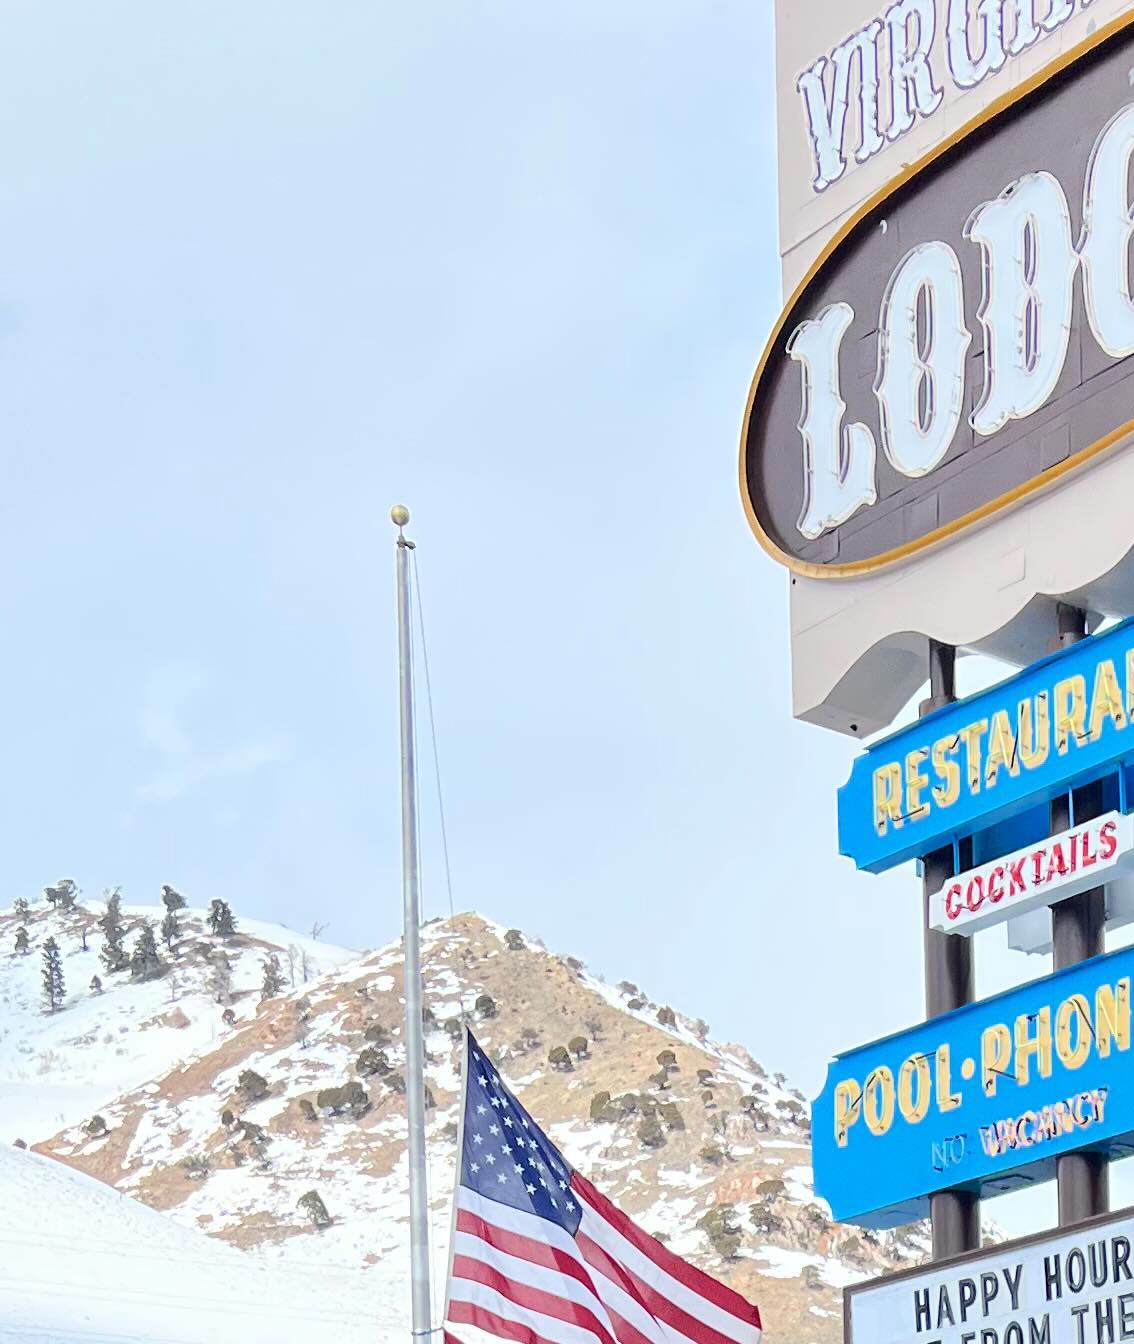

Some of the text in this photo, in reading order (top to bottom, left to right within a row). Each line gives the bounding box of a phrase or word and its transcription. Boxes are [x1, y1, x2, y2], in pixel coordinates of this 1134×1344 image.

[797, 0, 1092, 192] VIRG
[945, 821, 1118, 920] COCKTAILS
[834, 1043, 962, 1148] POOL
[931, 1087, 1117, 1172] NO VACANCY
[914, 1264, 1023, 1333] HAPPY
[1044, 1236, 1133, 1301] HOUR
